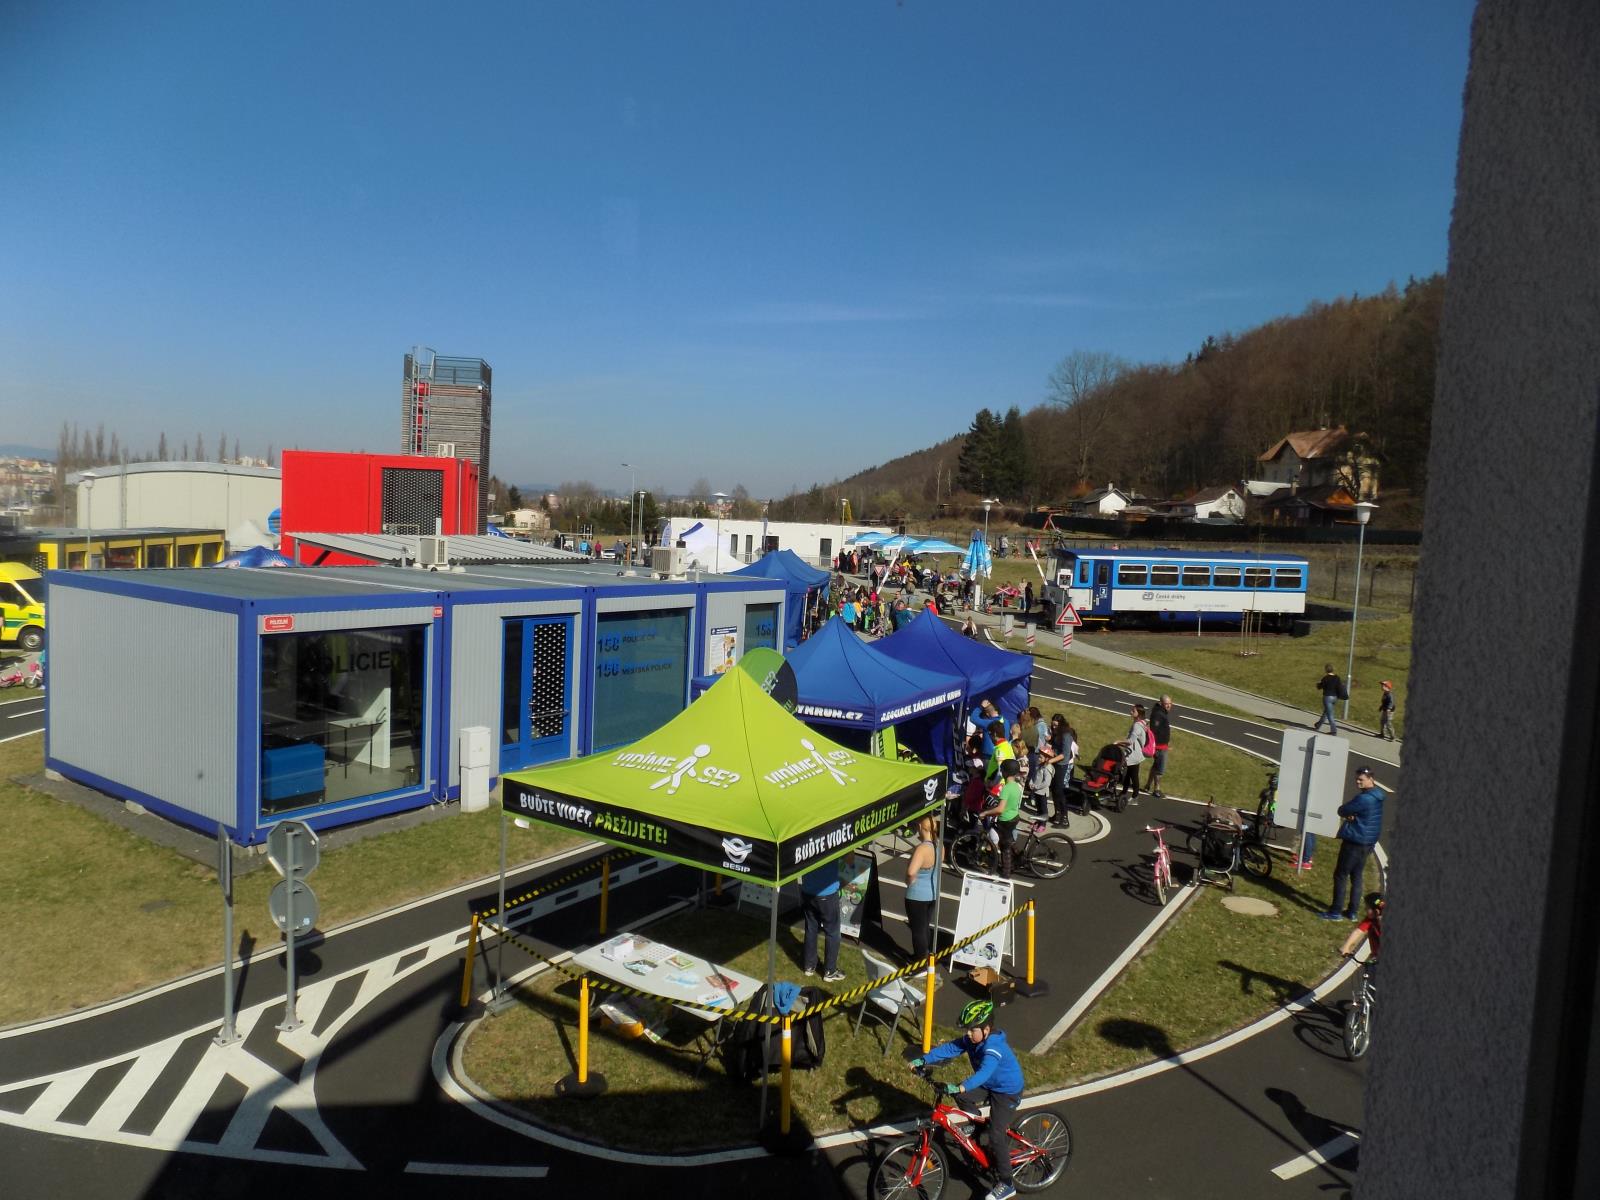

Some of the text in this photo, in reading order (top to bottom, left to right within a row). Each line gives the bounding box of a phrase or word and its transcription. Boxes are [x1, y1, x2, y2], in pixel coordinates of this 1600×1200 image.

[312, 650, 392, 675] OLICIE
[611, 752, 741, 789] VIDÍME SE?
[519, 792, 555, 816] BUĎTE
[594, 811, 668, 845] PŘEŽIJETE!
[794, 834, 826, 865] BUĎTE
[853, 801, 899, 836] PŘEŽIJETE!
[722, 860, 751, 873] BESIP
